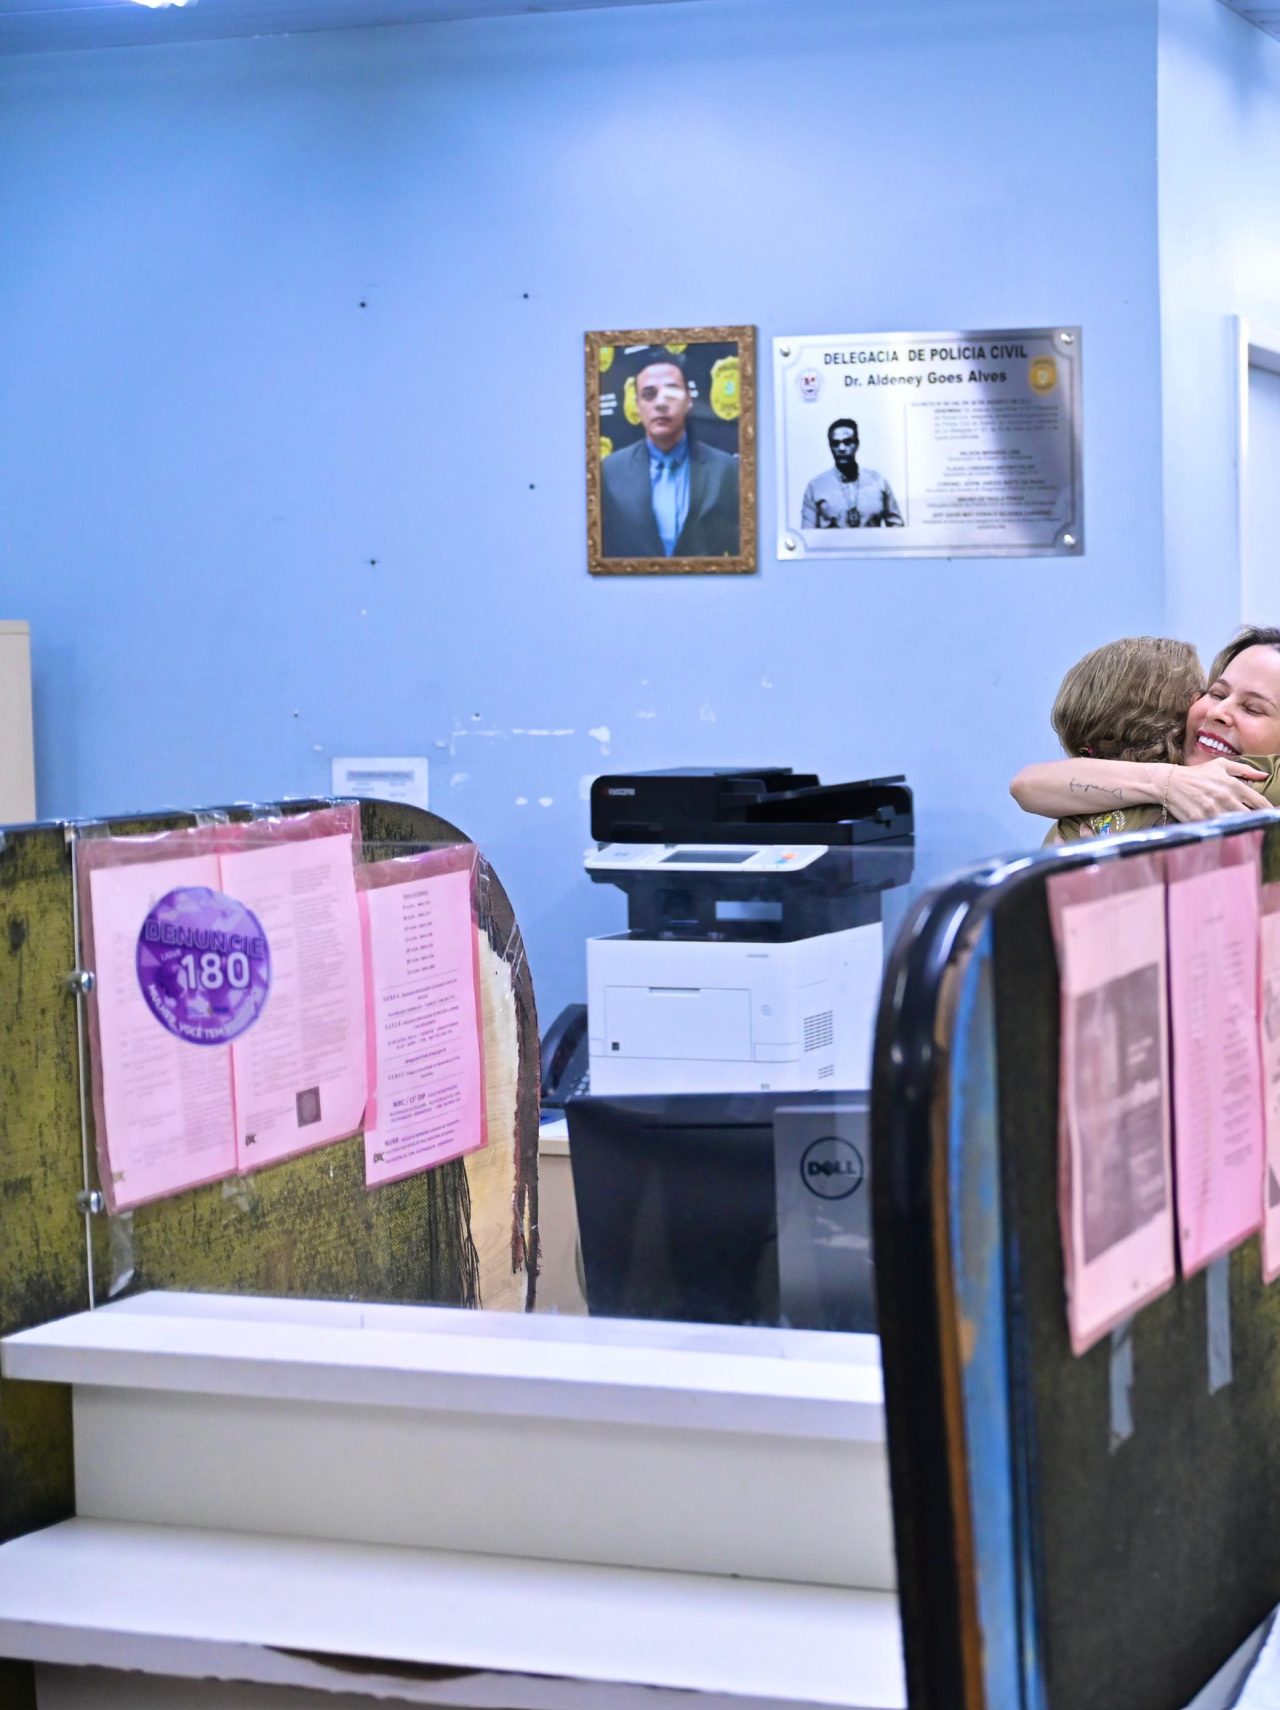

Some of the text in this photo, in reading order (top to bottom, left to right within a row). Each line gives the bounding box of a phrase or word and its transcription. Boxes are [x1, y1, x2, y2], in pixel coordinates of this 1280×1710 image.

[824, 345, 1028, 365] DELEGACIA DE POLÍCIA CIVIL
[844, 370, 1007, 388] Dr. Aldeney Goes Alves
[145, 919, 265, 960] DENUNCIE
[180, 951, 250, 990] 180
[807, 1160, 857, 1177] DELL
